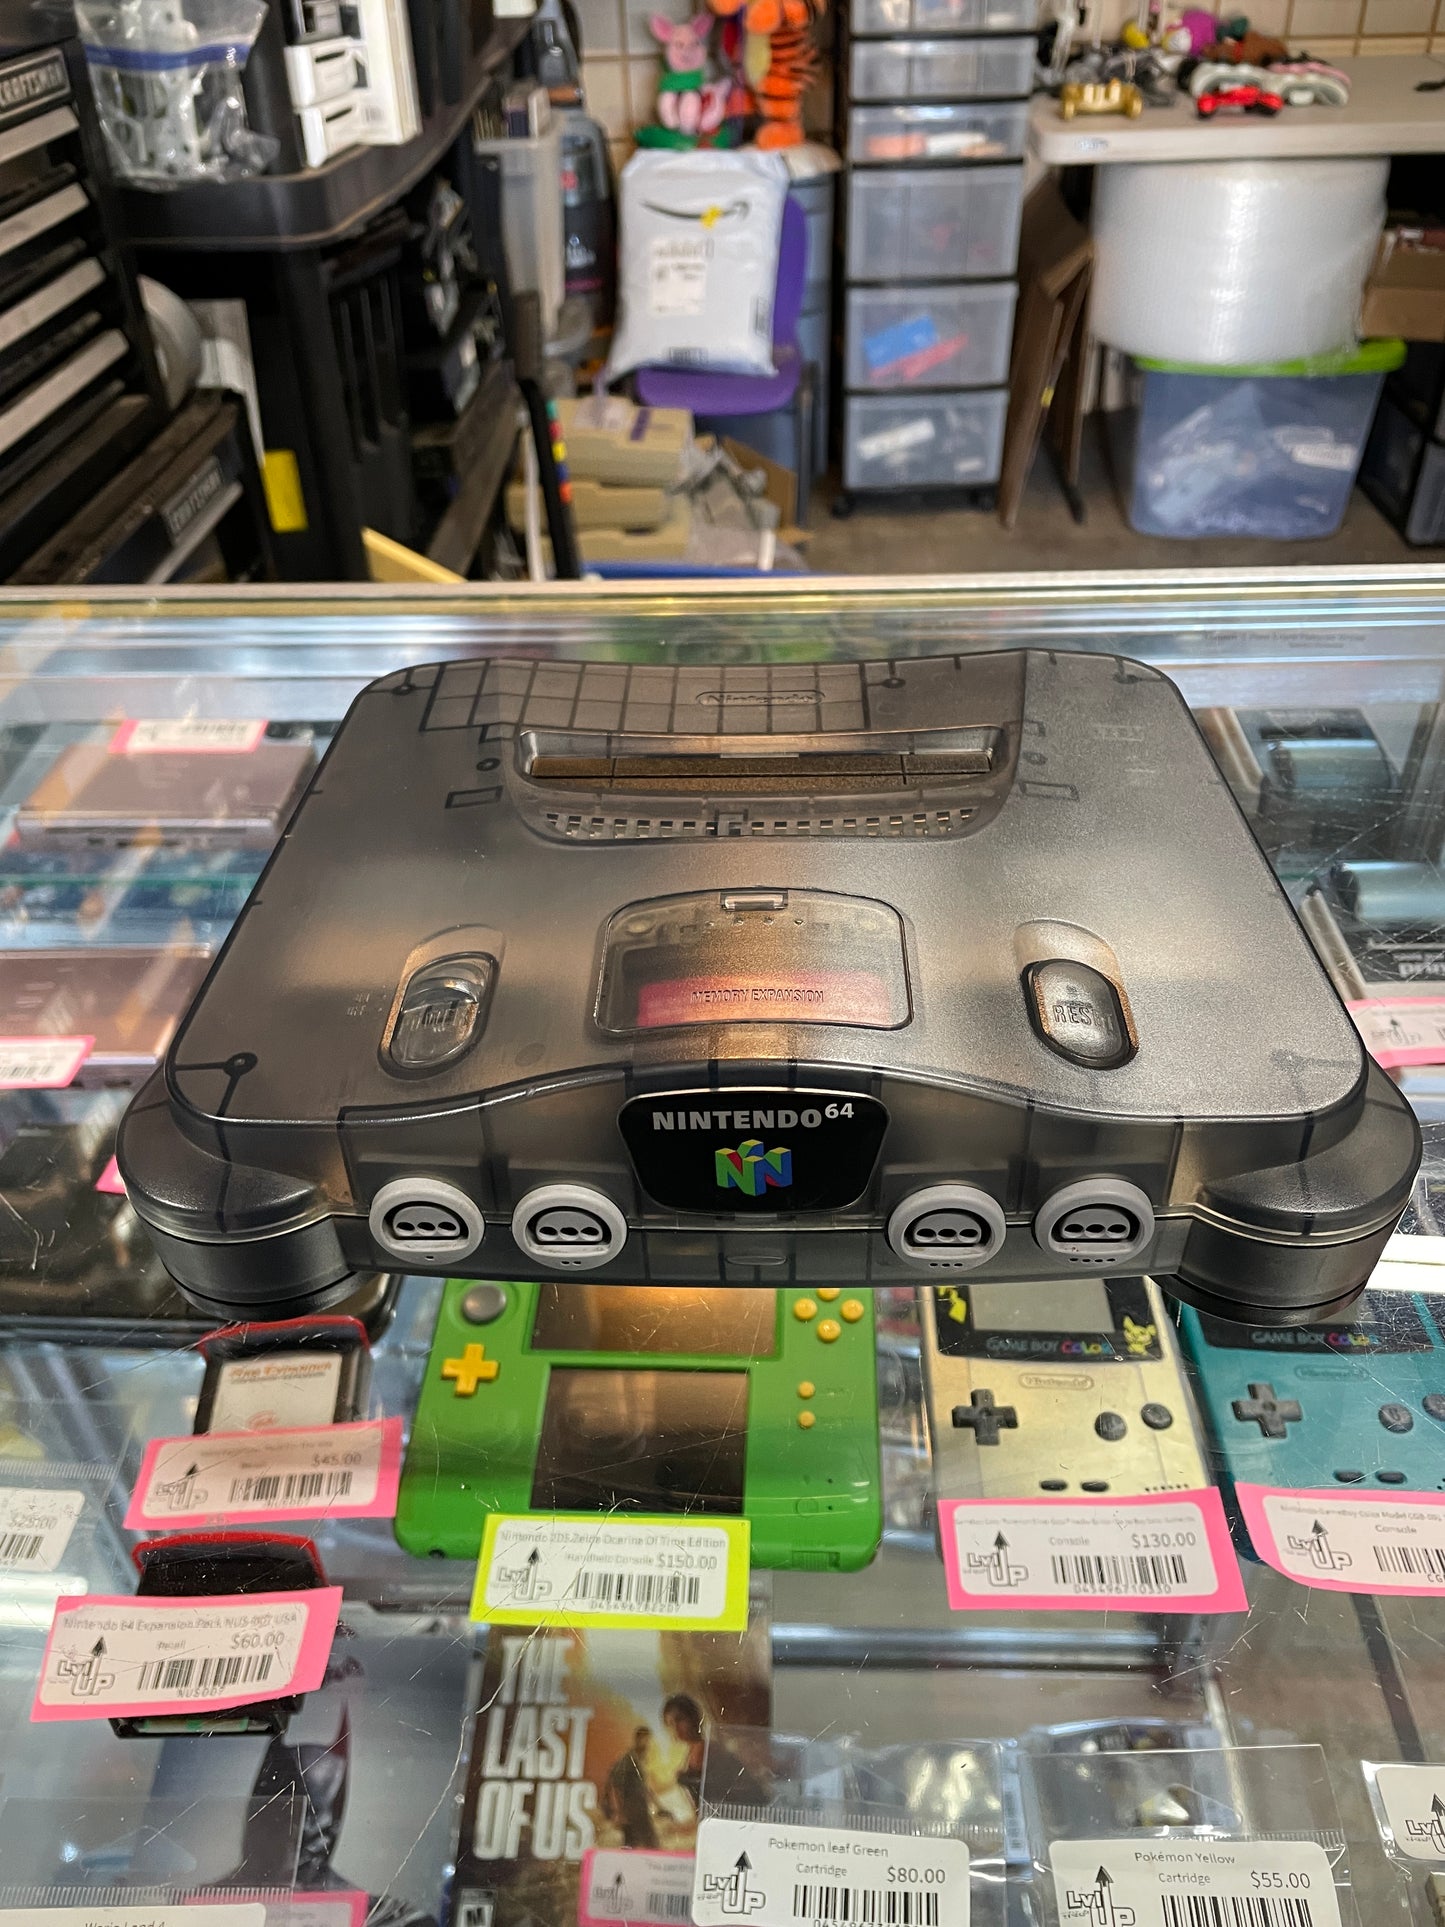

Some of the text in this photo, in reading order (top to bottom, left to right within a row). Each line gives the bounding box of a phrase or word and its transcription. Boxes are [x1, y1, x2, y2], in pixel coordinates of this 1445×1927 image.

[691, 988, 824, 1003] MEMORY EXPANSION
[652, 1103, 855, 1131] NINTENDO 64
[985, 1337, 1115, 1355] GAME BOY COLOR
[1252, 1331, 1295, 1345] GAME
[1296, 1333, 1325, 1345] BOY
[1375, 1524, 1417, 1535] Console
[501, 1530, 547, 1544] Nintendo
[688, 1537, 726, 1549] Edition
[1048, 1532, 1197, 1548] Console $130.00
[657, 1553, 718, 1570] $150.00
[967, 1552, 1000, 1568] Lvl
[1427, 1573, 1445, 1583] CG
[62, 1616, 118, 1631] Nintendo
[119, 1621, 135, 1631] 64
[137, 1619, 192, 1633] Expansion
[230, 1631, 285, 1650] $60.00
[57, 1659, 91, 1677] Lvl
[502, 1636, 575, 1705] THE
[481, 1706, 595, 1780] LAST
[473, 1780, 598, 1861] OF US
[768, 1837, 889, 1858] Pokemon leaf Green
[1134, 1851, 1236, 1865] Pokémon Yellow
[703, 1873, 738, 1891] Lvl
[796, 1863, 946, 1884] Cartridge $80.00
[1158, 1870, 1311, 1889] Cartridge $55.00
[1066, 1890, 1102, 1910] Lvl
